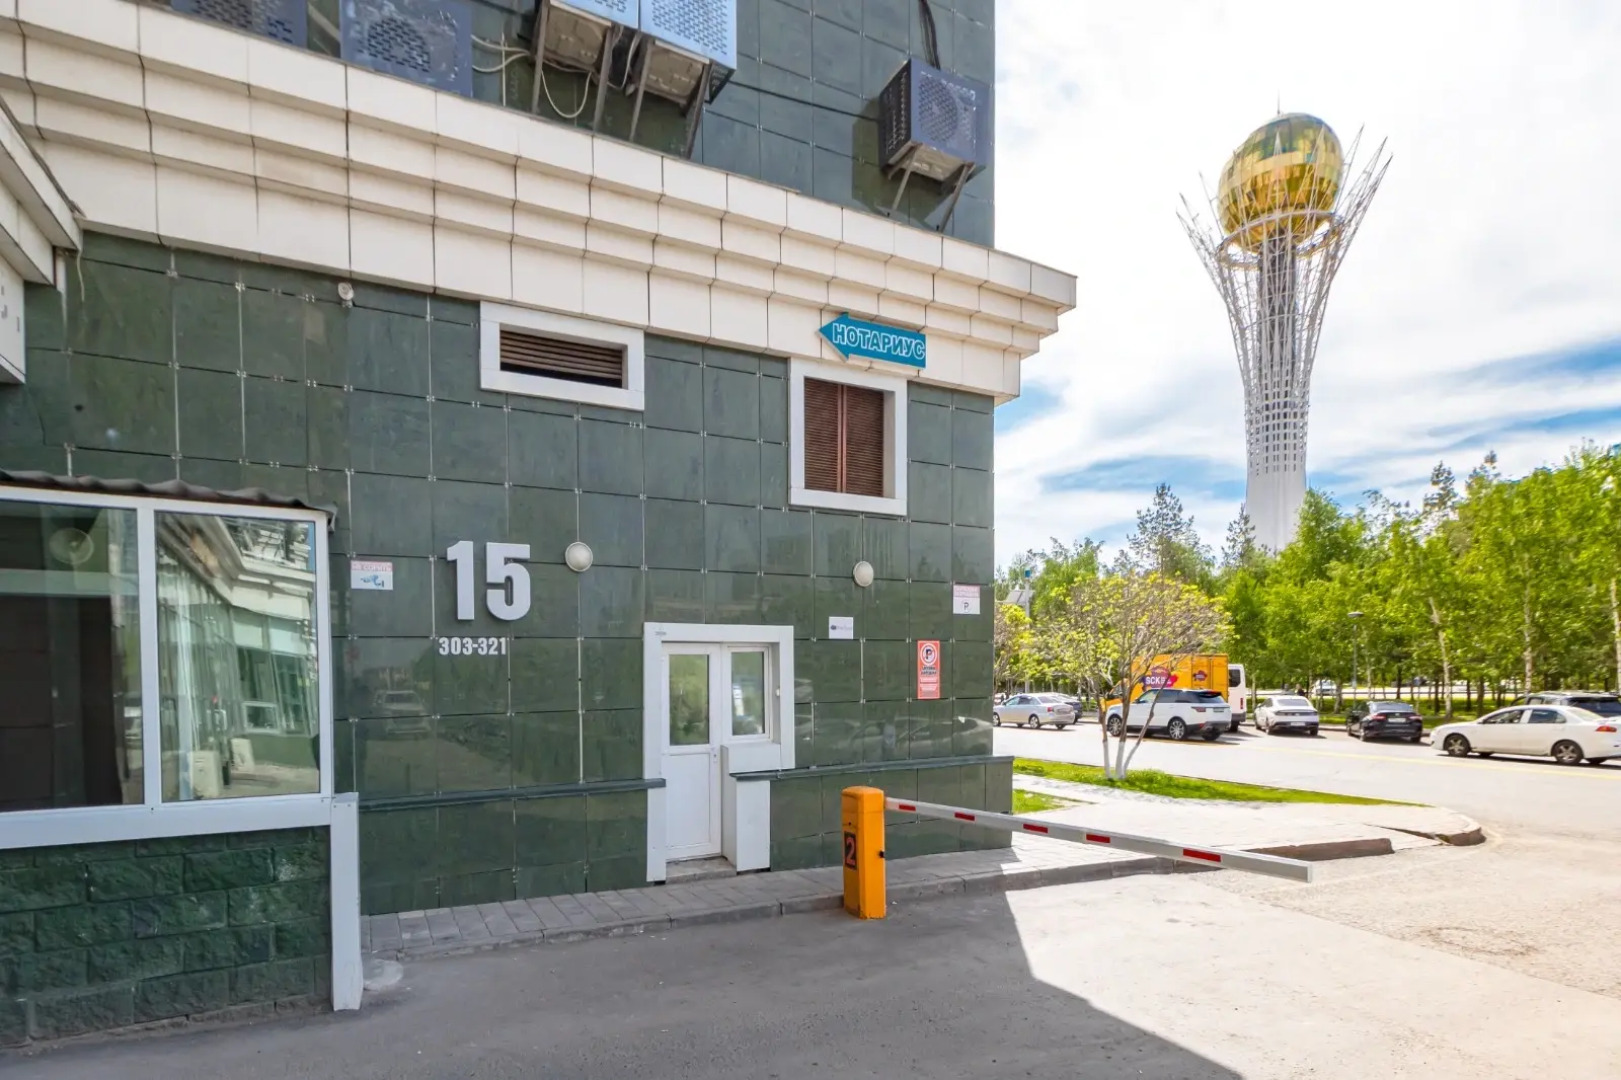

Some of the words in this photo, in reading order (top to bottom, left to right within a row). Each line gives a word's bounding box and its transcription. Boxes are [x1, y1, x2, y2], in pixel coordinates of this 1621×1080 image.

[832, 323, 926, 360] НОТАРИУС
[446, 540, 531, 621] 15
[438, 637, 507, 656] 303-321
[846, 836, 855, 866] 2
